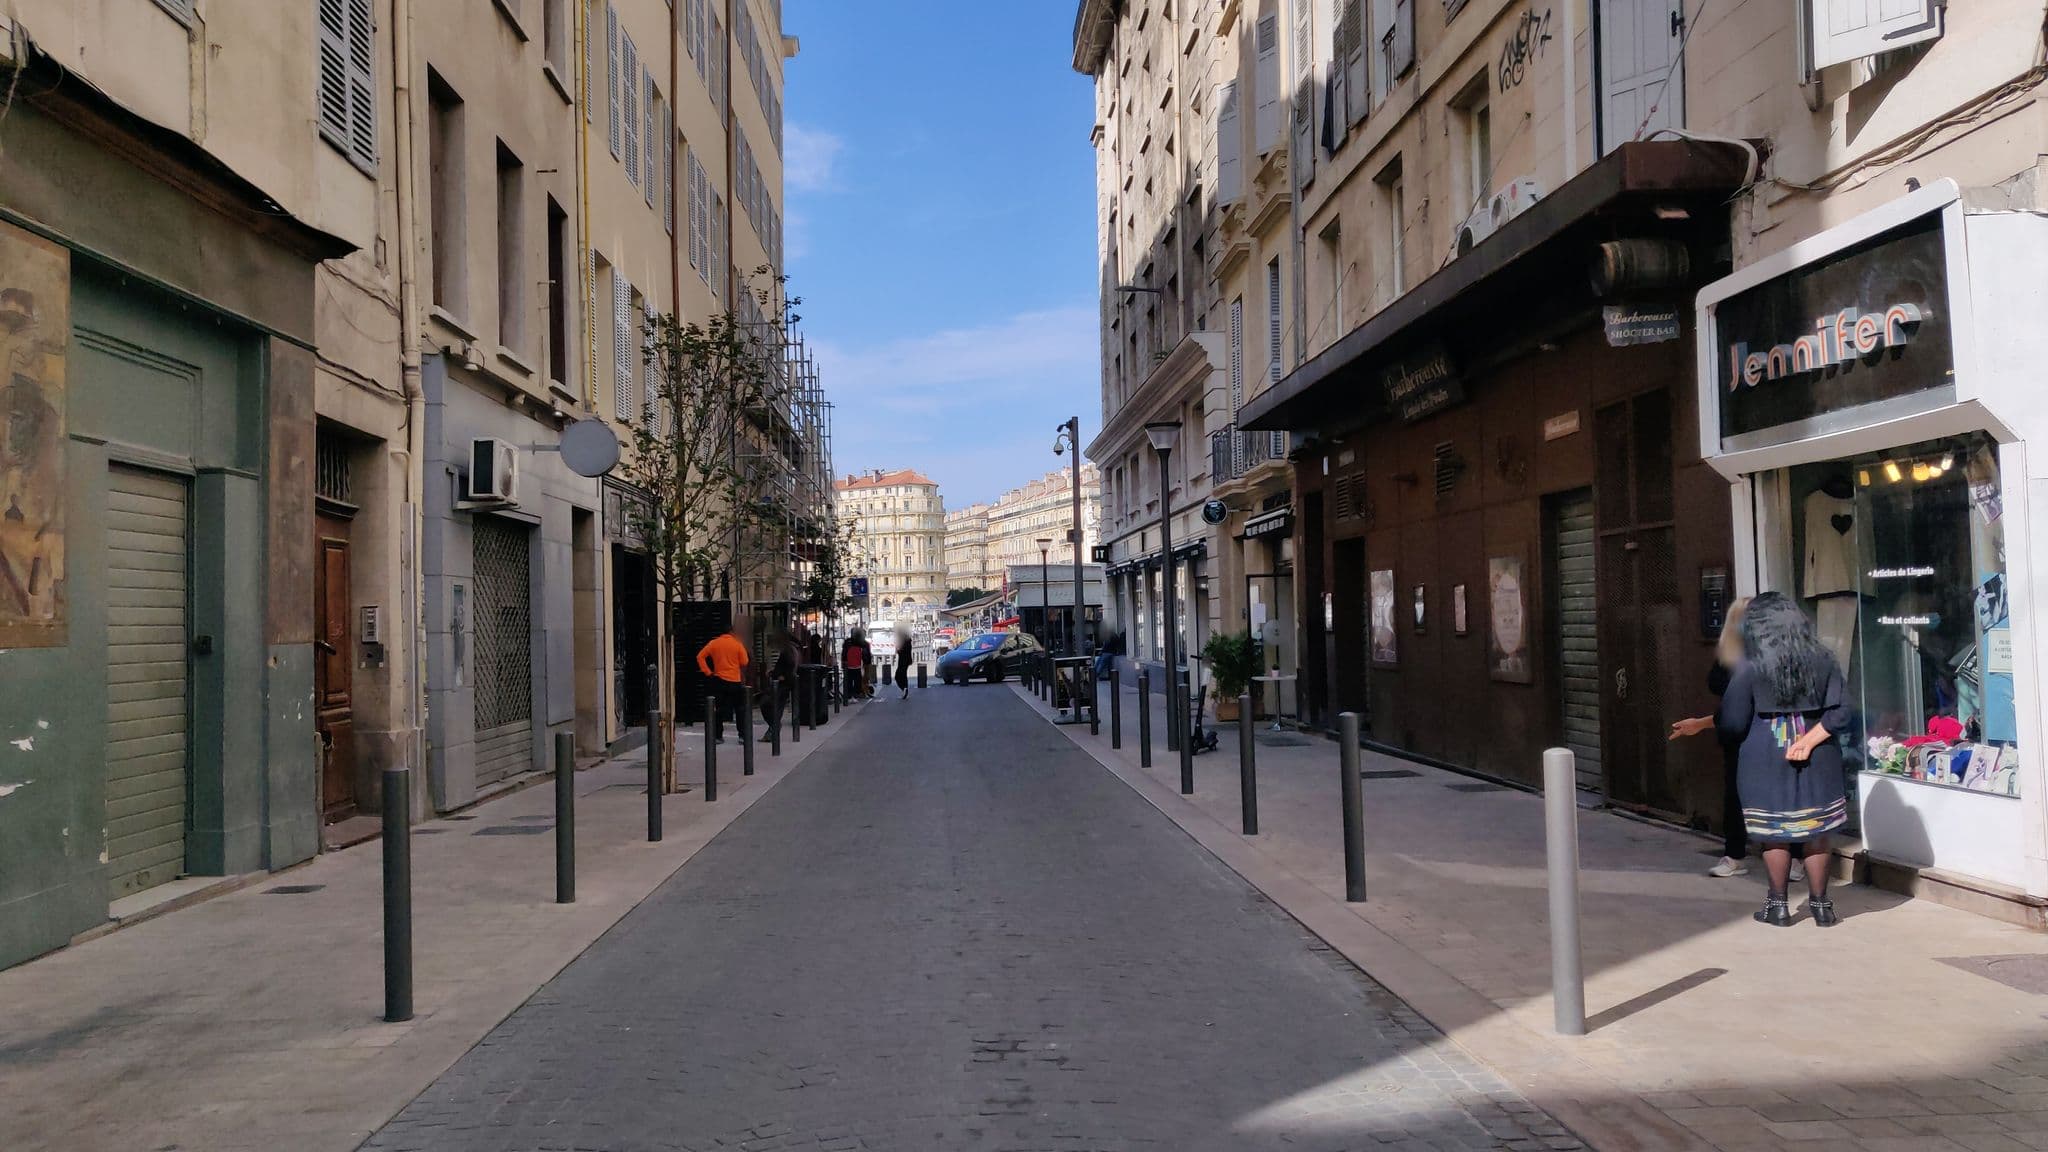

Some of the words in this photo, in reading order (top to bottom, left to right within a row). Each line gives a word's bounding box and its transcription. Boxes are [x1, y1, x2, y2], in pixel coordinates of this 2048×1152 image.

[1609, 311, 1674, 326] Barberousse
[1657, 325, 1675, 337] BAR
[1729, 303, 1921, 392] Jennifer
[1095, 549, 1105, 559] IT
[1872, 568, 1897, 578] Articles
[1897, 567, 1907, 576] de
[1906, 566, 1935, 577] Lingerie
[1895, 616, 1903, 625] et
[1903, 616, 1930, 625] collants
